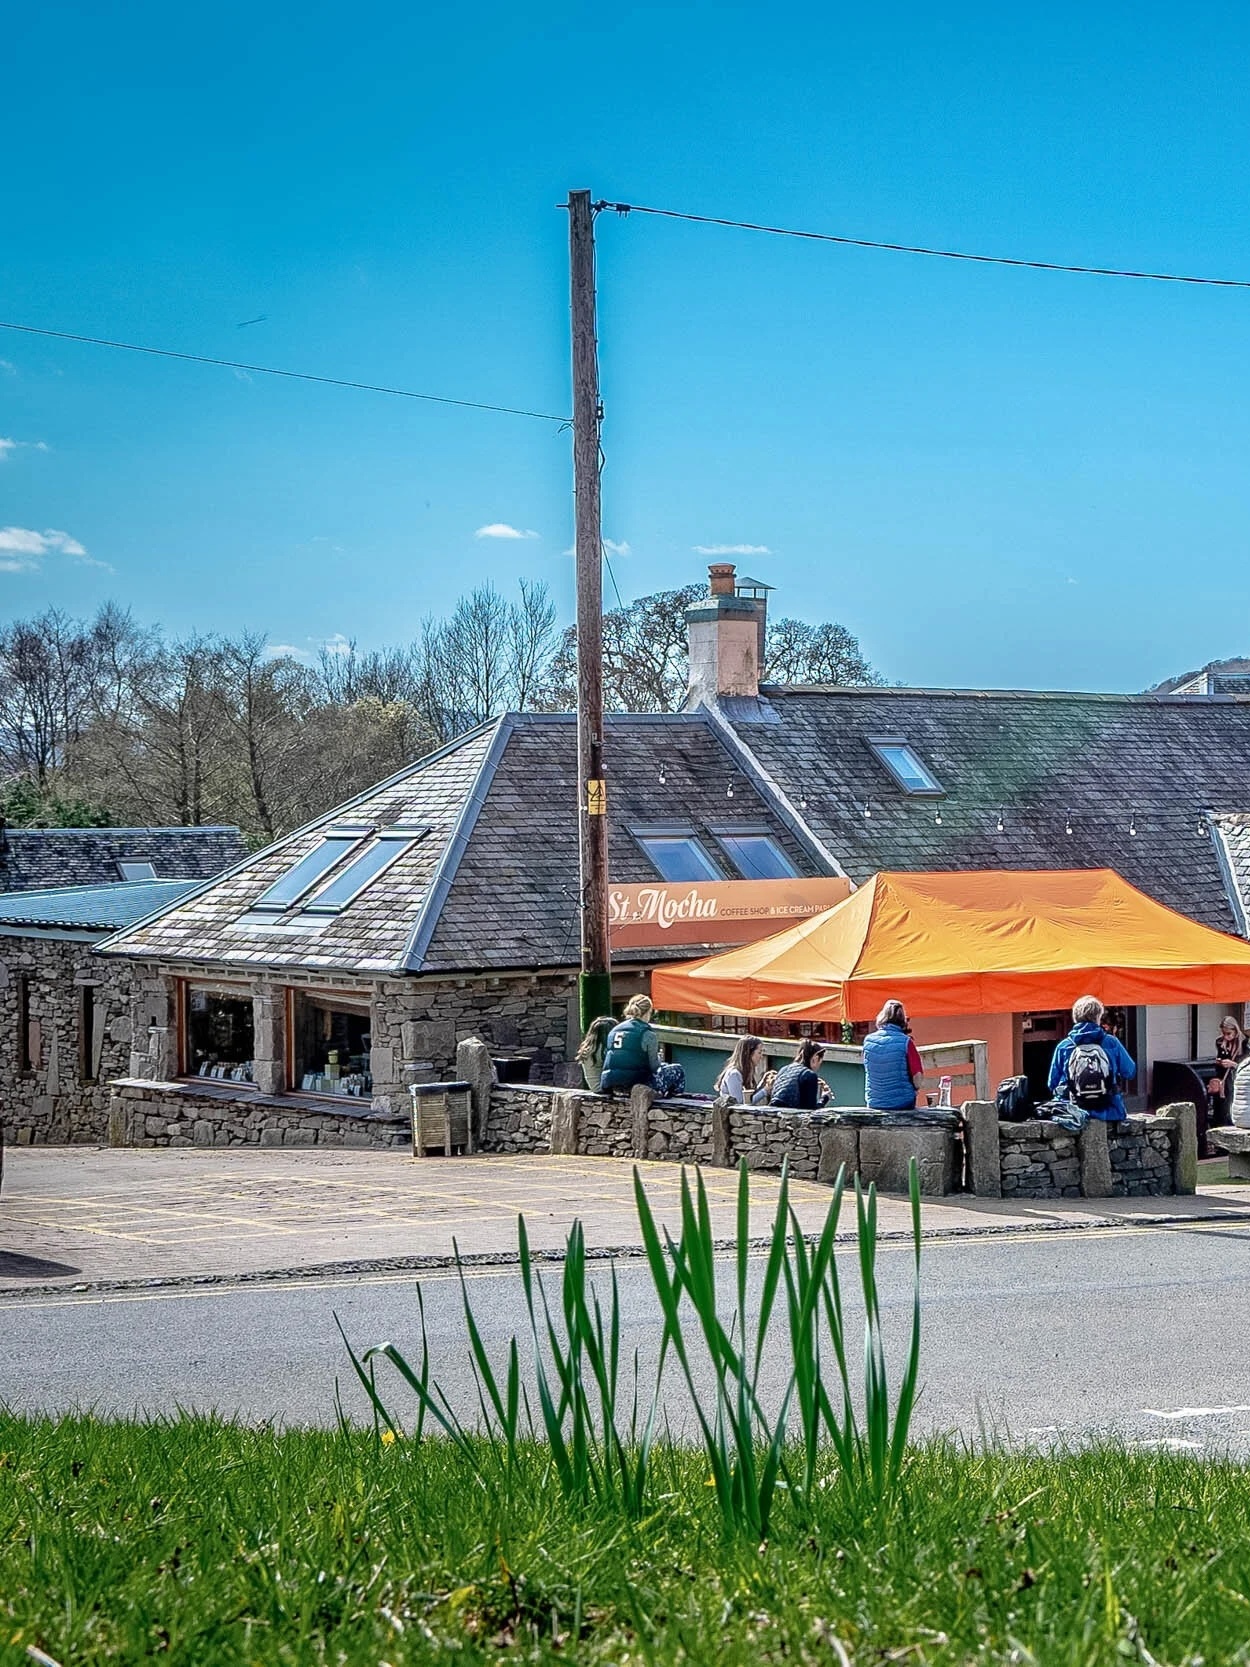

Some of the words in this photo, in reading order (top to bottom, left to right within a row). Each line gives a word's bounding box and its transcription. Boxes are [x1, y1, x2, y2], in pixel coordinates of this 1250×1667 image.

[608, 890, 630, 922] St
[631, 888, 719, 930] Mocha
[719, 906, 749, 917] COFFEE
[749, 906, 770, 916] SHOP
[770, 904, 776, 915] &
[776, 904, 789, 915] ICE
[789, 902, 815, 915] CREAM
[814, 902, 836, 914] PAR
[613, 1031, 624, 1049] 5
